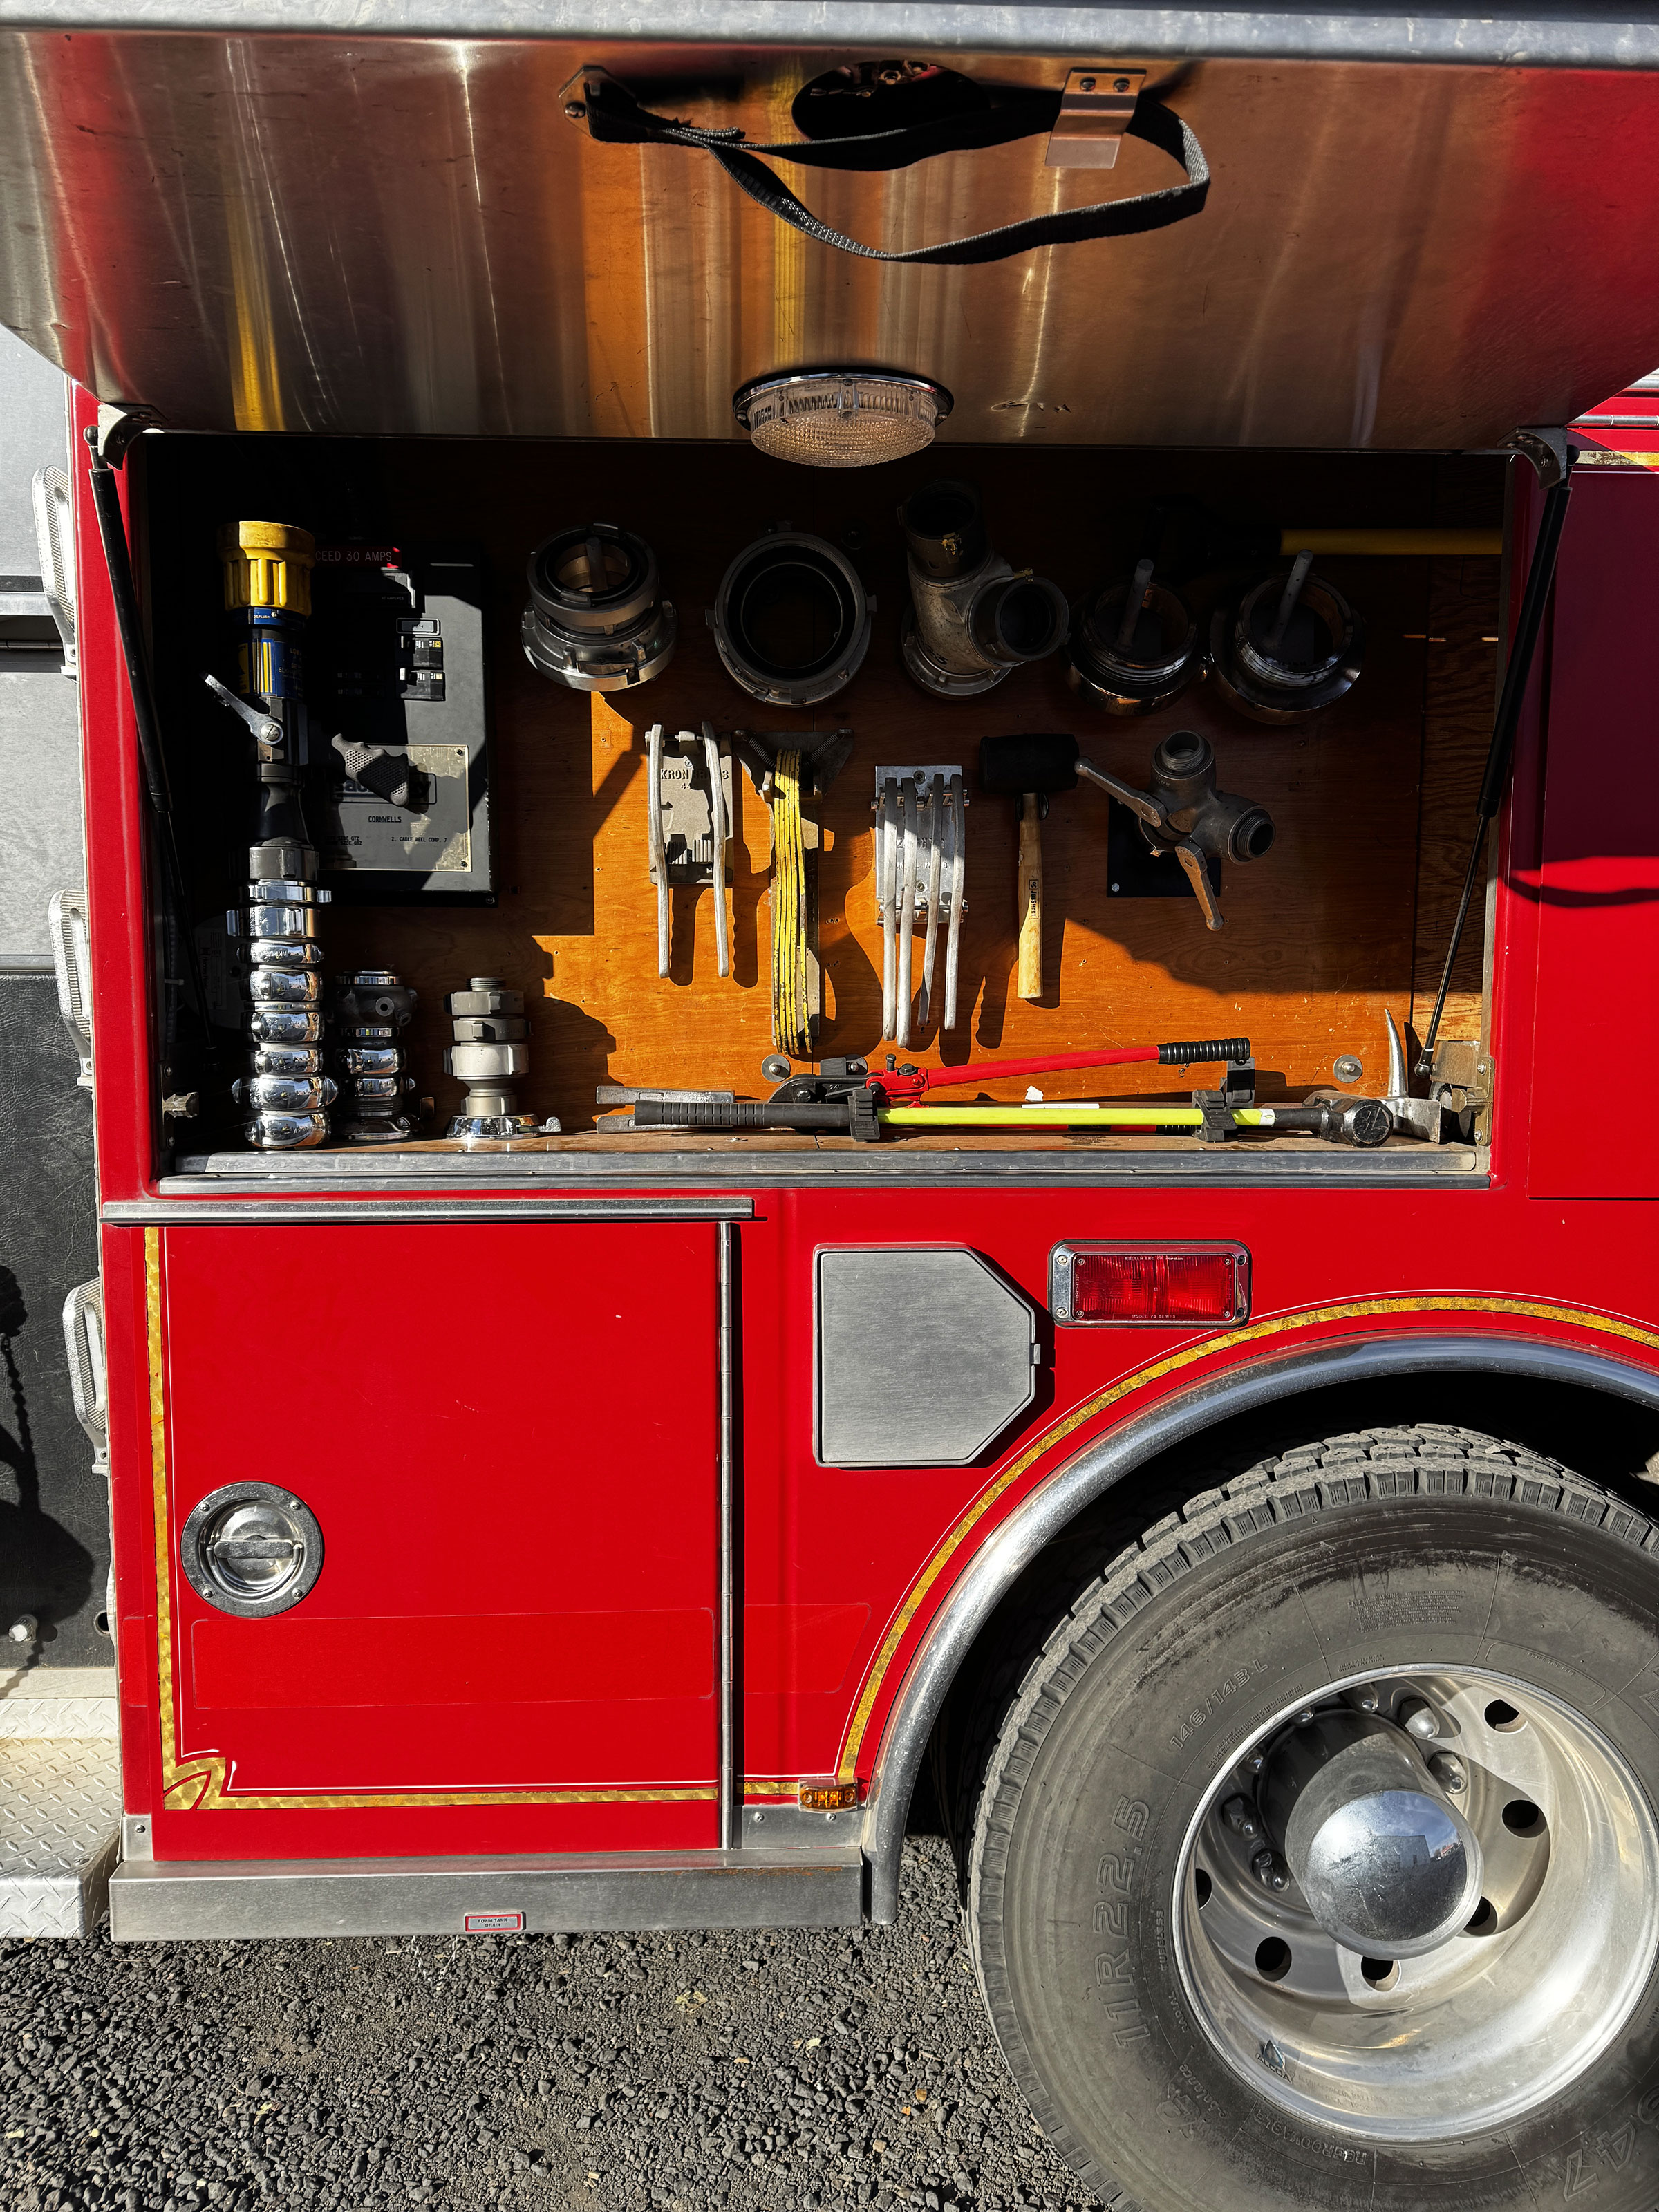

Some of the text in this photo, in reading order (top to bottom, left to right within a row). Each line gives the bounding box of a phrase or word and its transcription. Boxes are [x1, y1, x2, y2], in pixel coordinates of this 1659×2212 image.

[315, 551, 392, 562] CEED 30 AMPS
[661, 769, 689, 780] KRON
[1093, 1794, 1151, 2049] 11R22.5
[1156, 1909, 1167, 1971] TUBELESS
[1168, 1991, 1190, 2034] RADIAL
[1257, 2054, 1293, 2084] ALCOA
[1254, 2109, 1368, 2166] REGROOVABLE
